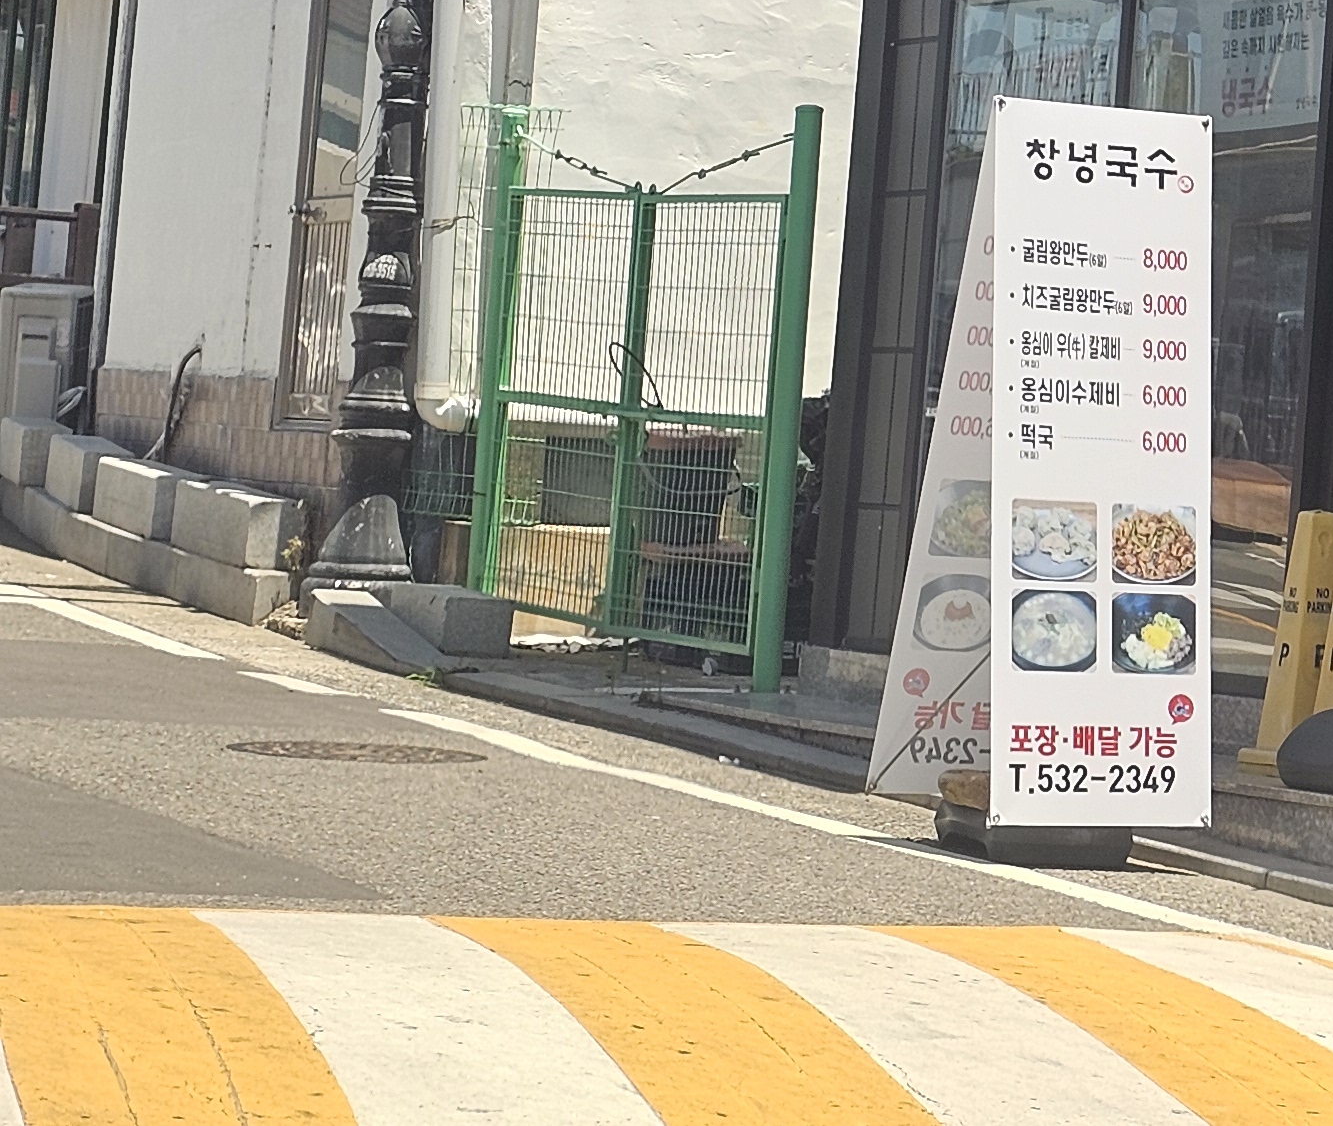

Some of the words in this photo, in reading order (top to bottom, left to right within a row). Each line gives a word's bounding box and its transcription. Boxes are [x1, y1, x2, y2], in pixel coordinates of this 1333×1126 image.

[1025, 138, 1178, 191] 창녕국수
[1143, 248, 1188, 271] 8,000
[1143, 294, 1187, 317] 9,000
[1021, 330, 1053, 356] 옹심이
[1089, 335, 1121, 361] 칼제비
[1143, 339, 1187, 362] 9,000
[1021, 377, 1120, 407] 옹심이수제비
[1143, 384, 1187, 408] 6,000
[1021, 424, 1054, 450] 떡국
[1143, 431, 1187, 454] 6,000
[1307, 601, 1332, 613] PARKIN
[1316, 587, 1330, 599] NO
[1279, 642, 1290, 667] P
[1129, 726, 1178, 759] 가능
[1009, 763, 1176, 795] T.532-2349
